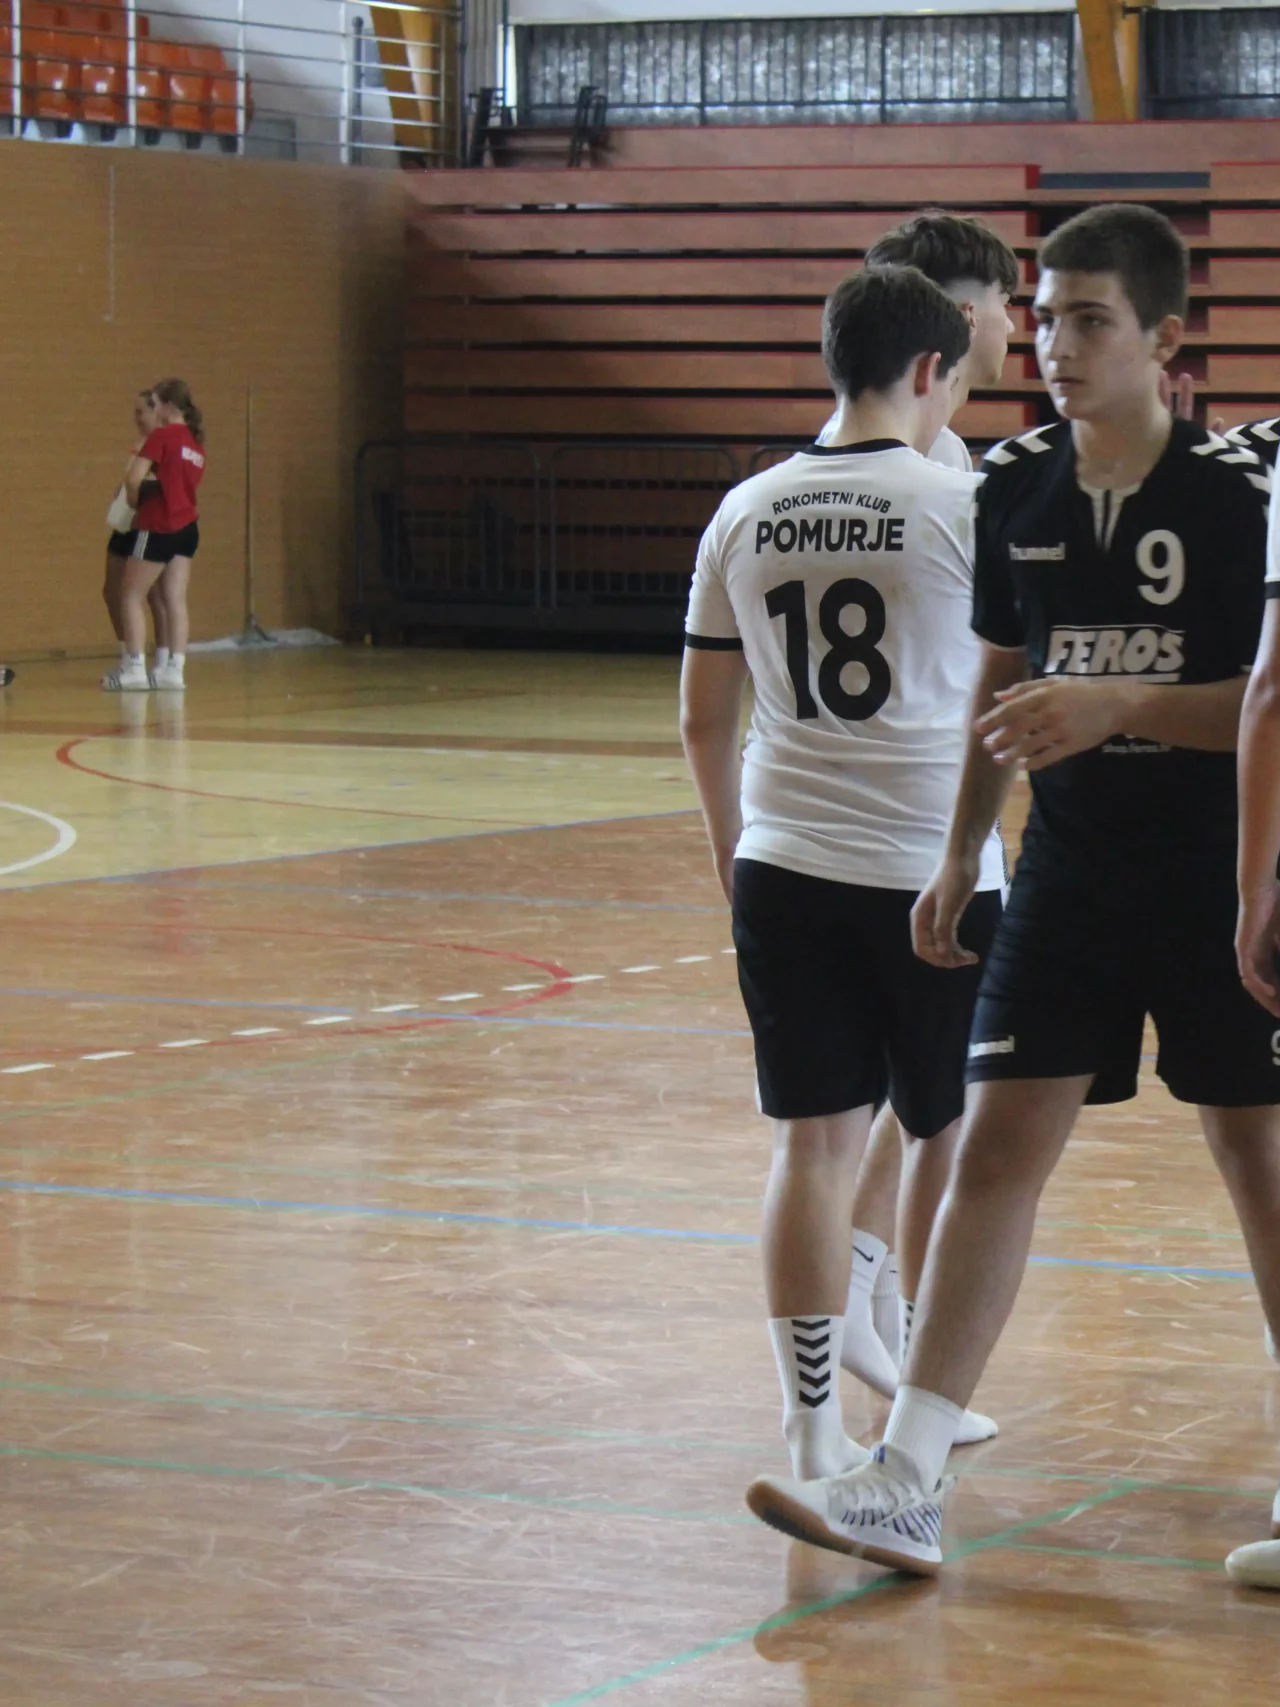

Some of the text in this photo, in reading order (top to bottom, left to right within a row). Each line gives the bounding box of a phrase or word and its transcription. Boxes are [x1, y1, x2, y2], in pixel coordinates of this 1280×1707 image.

[771, 491, 892, 515] ROKOMETNI KLUB
[755, 517, 905, 554] POMURJE
[1135, 528, 1186, 606] 9
[764, 577, 892, 722] 18
[1043, 628, 1185, 674] FEROS
